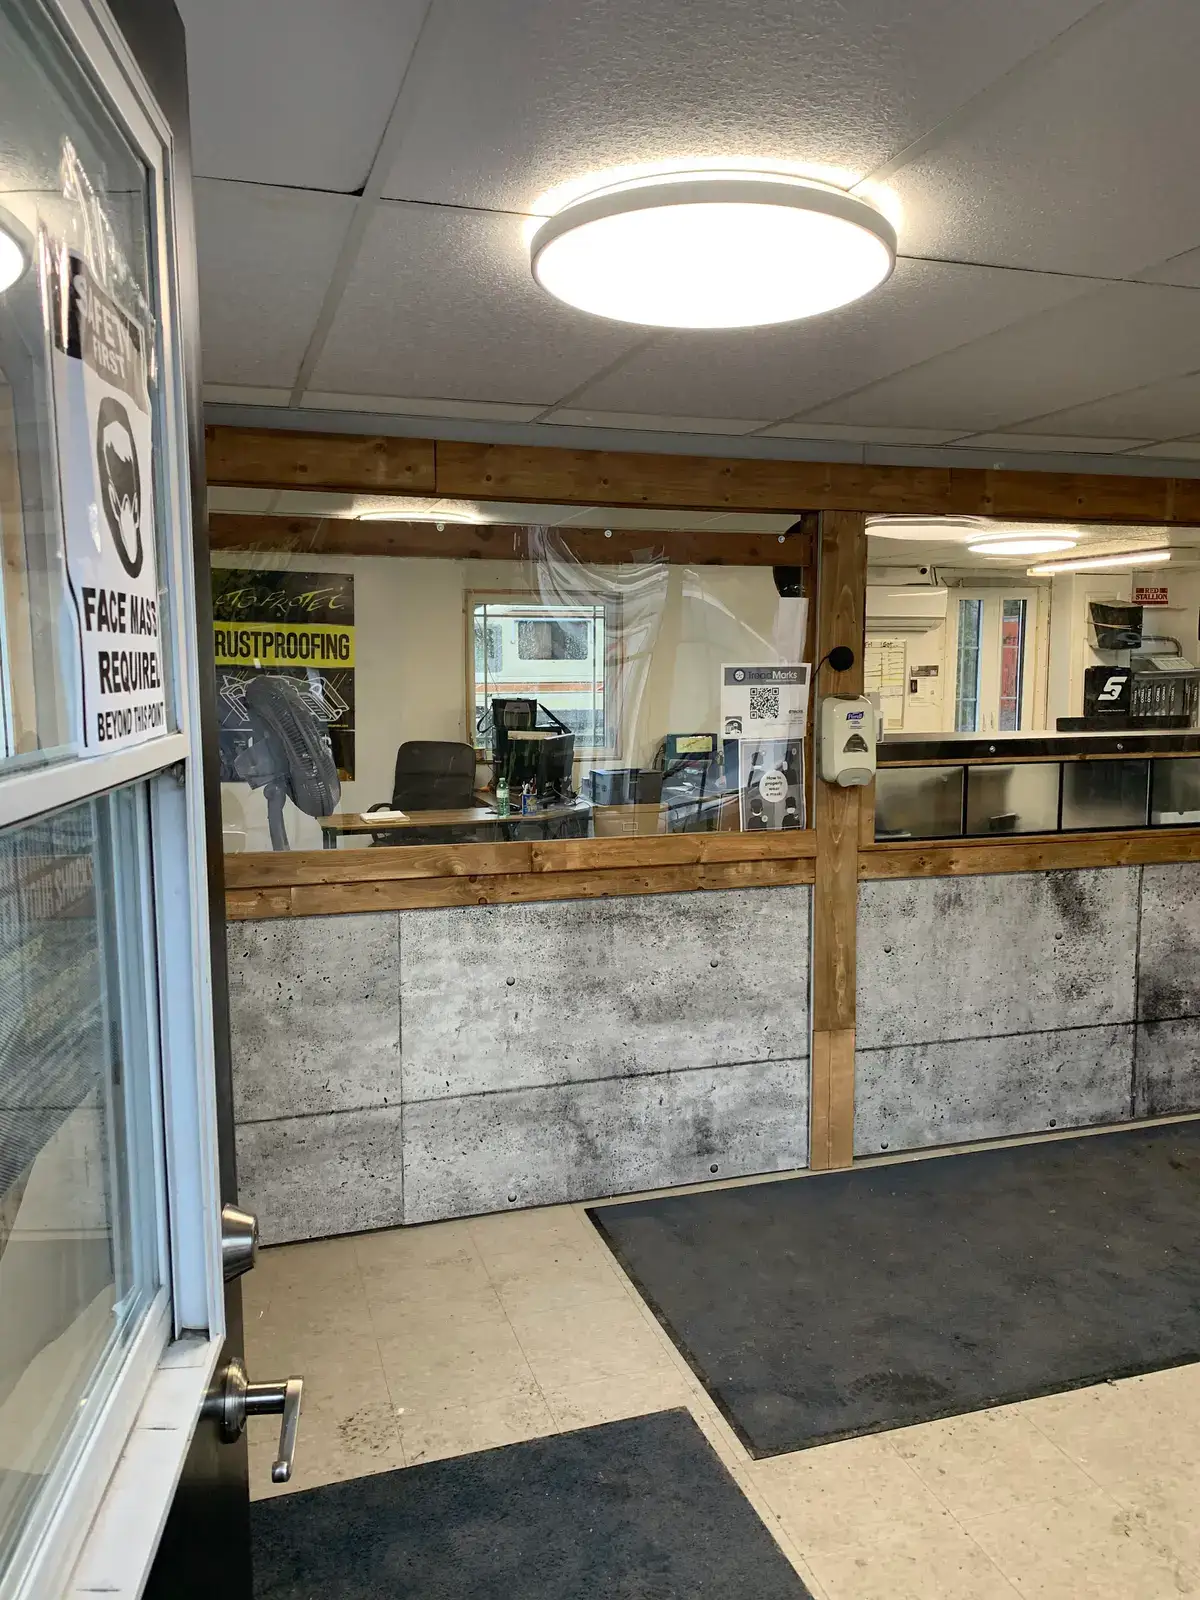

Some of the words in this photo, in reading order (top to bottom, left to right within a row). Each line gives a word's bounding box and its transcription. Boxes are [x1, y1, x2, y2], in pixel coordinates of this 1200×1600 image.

[73, 274, 131, 362] SAFETY
[92, 333, 125, 380] FIRST
[82, 587, 126, 634] FACE
[214, 629, 350, 660] RUSTPROOFING
[97, 708, 132, 742] BEYOND
[133, 705, 148, 733] THIS
[148, 701, 164, 728] POINT
